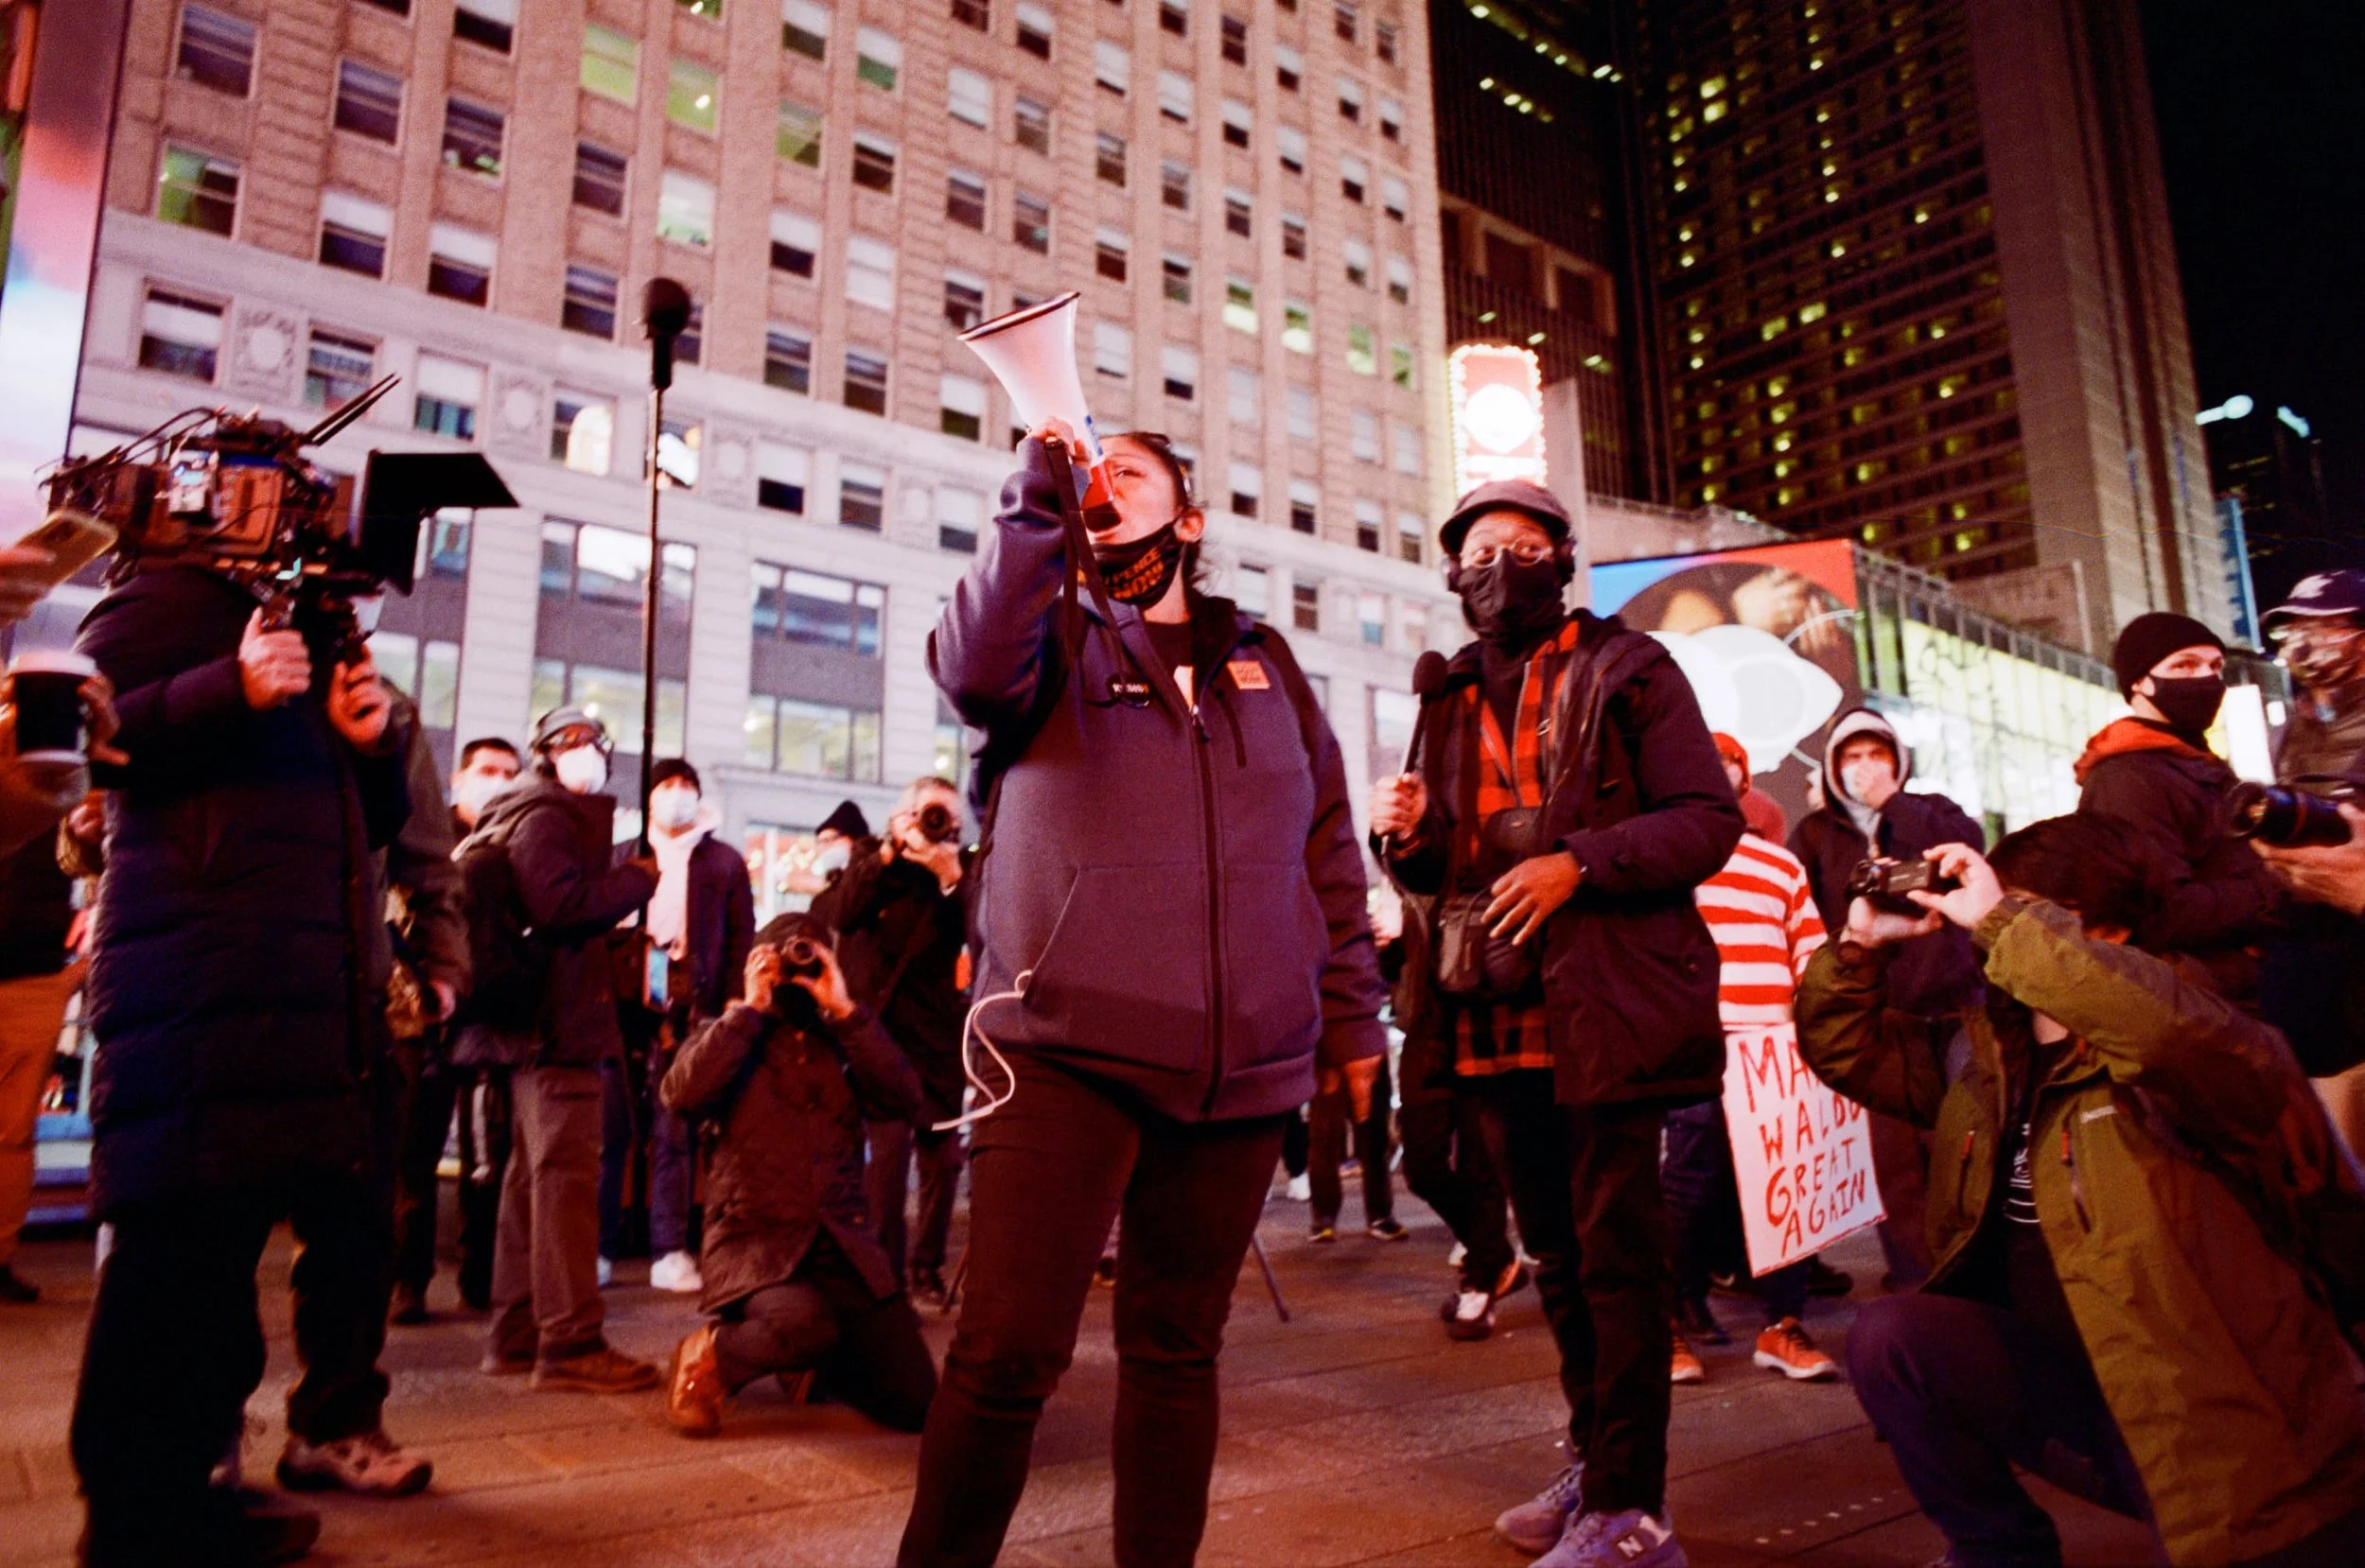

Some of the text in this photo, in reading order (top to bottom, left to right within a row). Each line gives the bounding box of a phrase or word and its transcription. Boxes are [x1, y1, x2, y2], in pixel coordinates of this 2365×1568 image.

[1739, 1036, 1821, 1113] MA
[1765, 1136, 1857, 1227] GREAT
[1781, 1169, 1866, 1258] AGAIN
[1617, 1534, 1643, 1558] N
